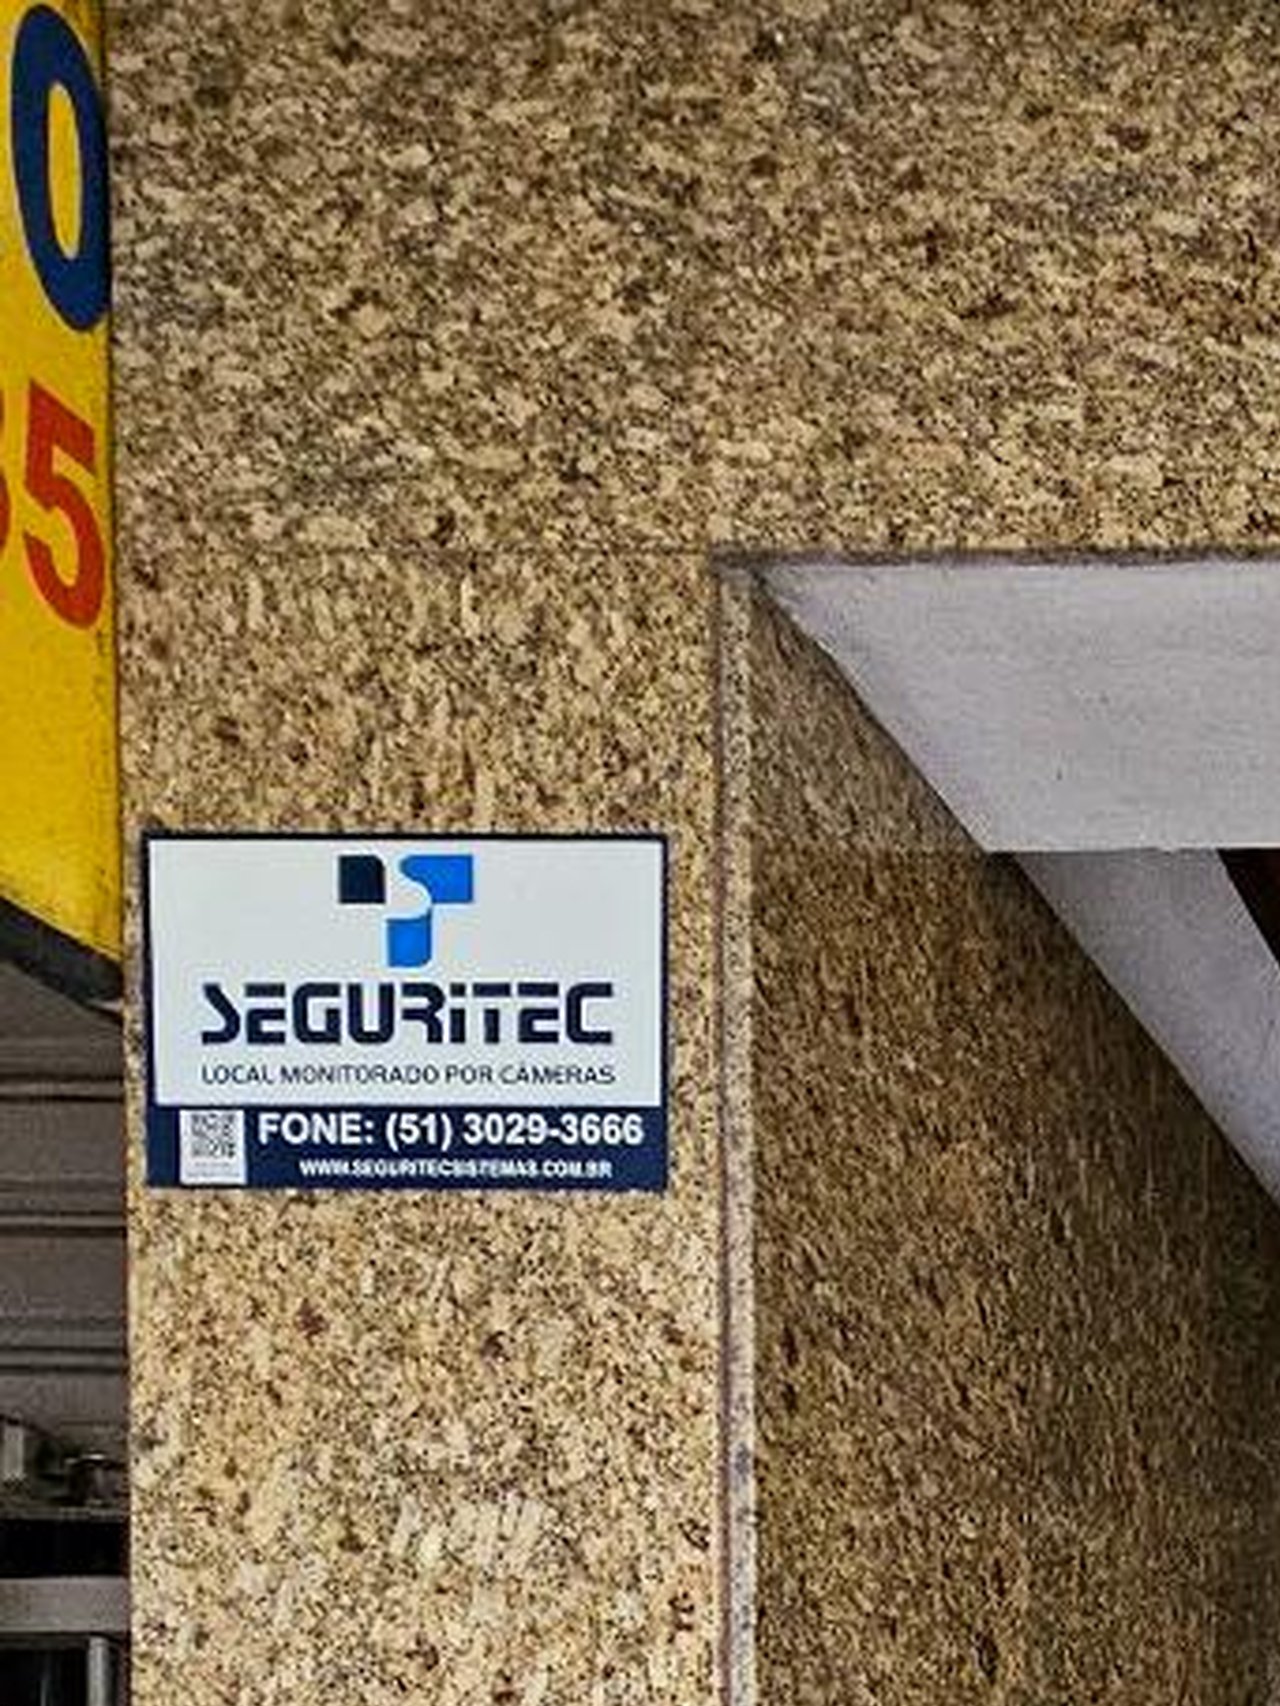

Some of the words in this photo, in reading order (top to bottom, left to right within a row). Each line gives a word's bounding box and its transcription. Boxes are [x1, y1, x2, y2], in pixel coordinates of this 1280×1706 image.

[201, 982, 614, 1045] SEGURITEC
[201, 1065, 274, 1086] LOCAL
[280, 1065, 439, 1086] MONITORADO
[444, 1065, 494, 1085] POR
[257, 1113, 374, 1145] FONE:
[386, 1112, 452, 1152] (51)
[463, 1113, 645, 1145] 3029-3666
